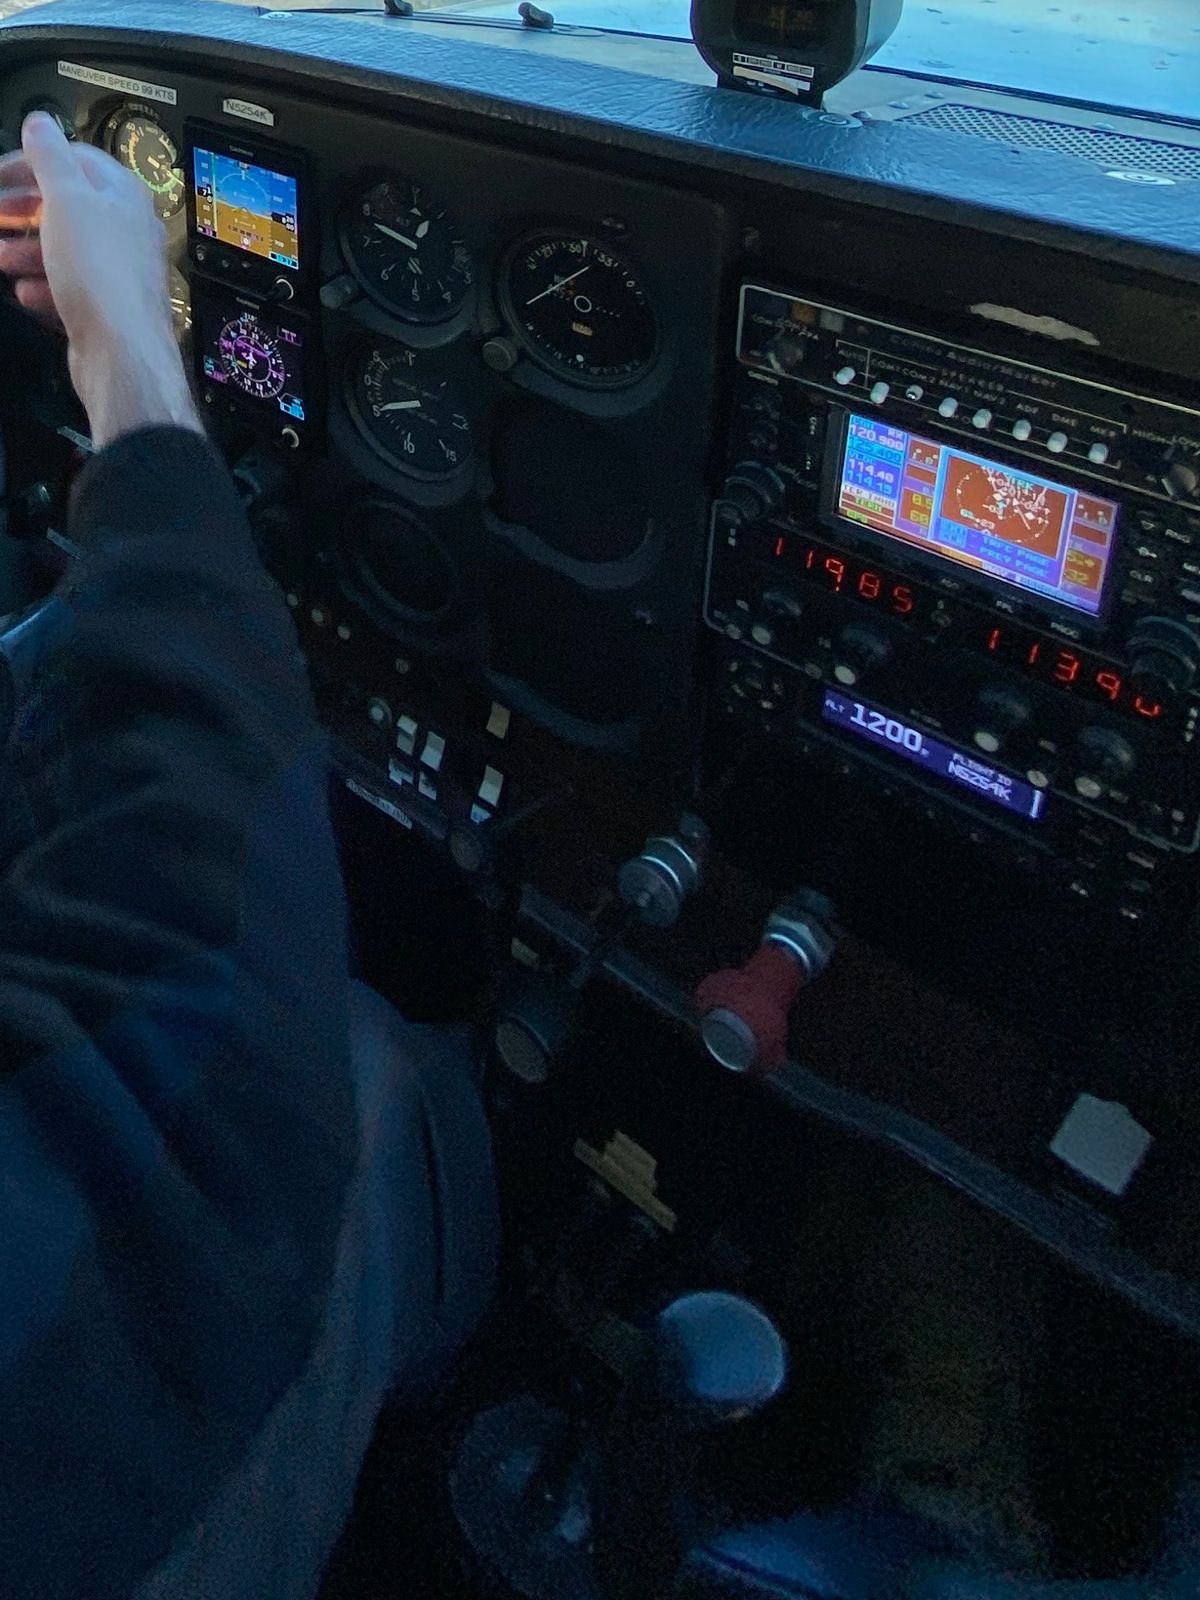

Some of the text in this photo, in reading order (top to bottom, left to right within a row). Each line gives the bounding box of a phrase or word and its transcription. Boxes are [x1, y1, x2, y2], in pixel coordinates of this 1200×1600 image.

[59, 62, 175, 102] MANEUVER SPEED 99 KTS
[226, 99, 267, 121] N5254K
[1051, 412, 1078, 427] DME
[850, 424, 904, 452] 120.900
[446, 448, 457, 462] 15
[847, 471, 893, 495] 114.15
[848, 459, 895, 484] 114.40
[825, 697, 845, 716] ALT
[850, 701, 921, 753] 1200
